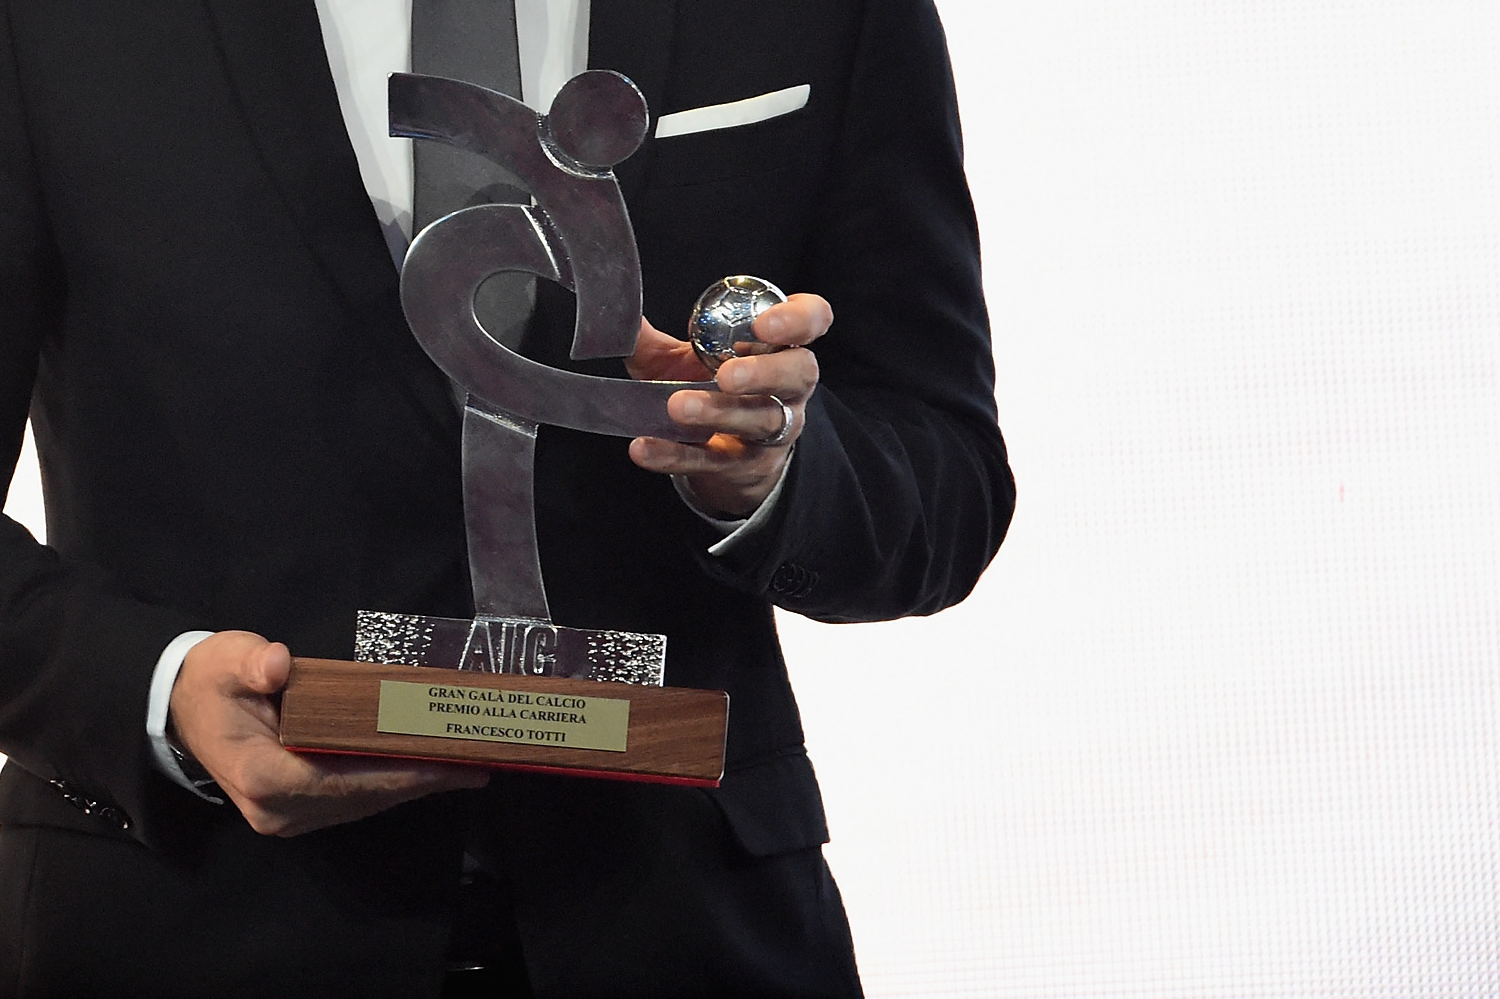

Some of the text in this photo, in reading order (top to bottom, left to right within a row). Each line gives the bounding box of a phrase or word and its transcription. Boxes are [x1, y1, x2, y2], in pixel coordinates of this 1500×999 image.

[458, 621, 558, 677] AIC
[428, 687, 586, 710] GRAN GALÀ DEL CALCIO
[428, 702, 587, 724] PREMIO ALLA CARRIERA
[446, 723, 566, 742] FRANCESCO TOTTI
